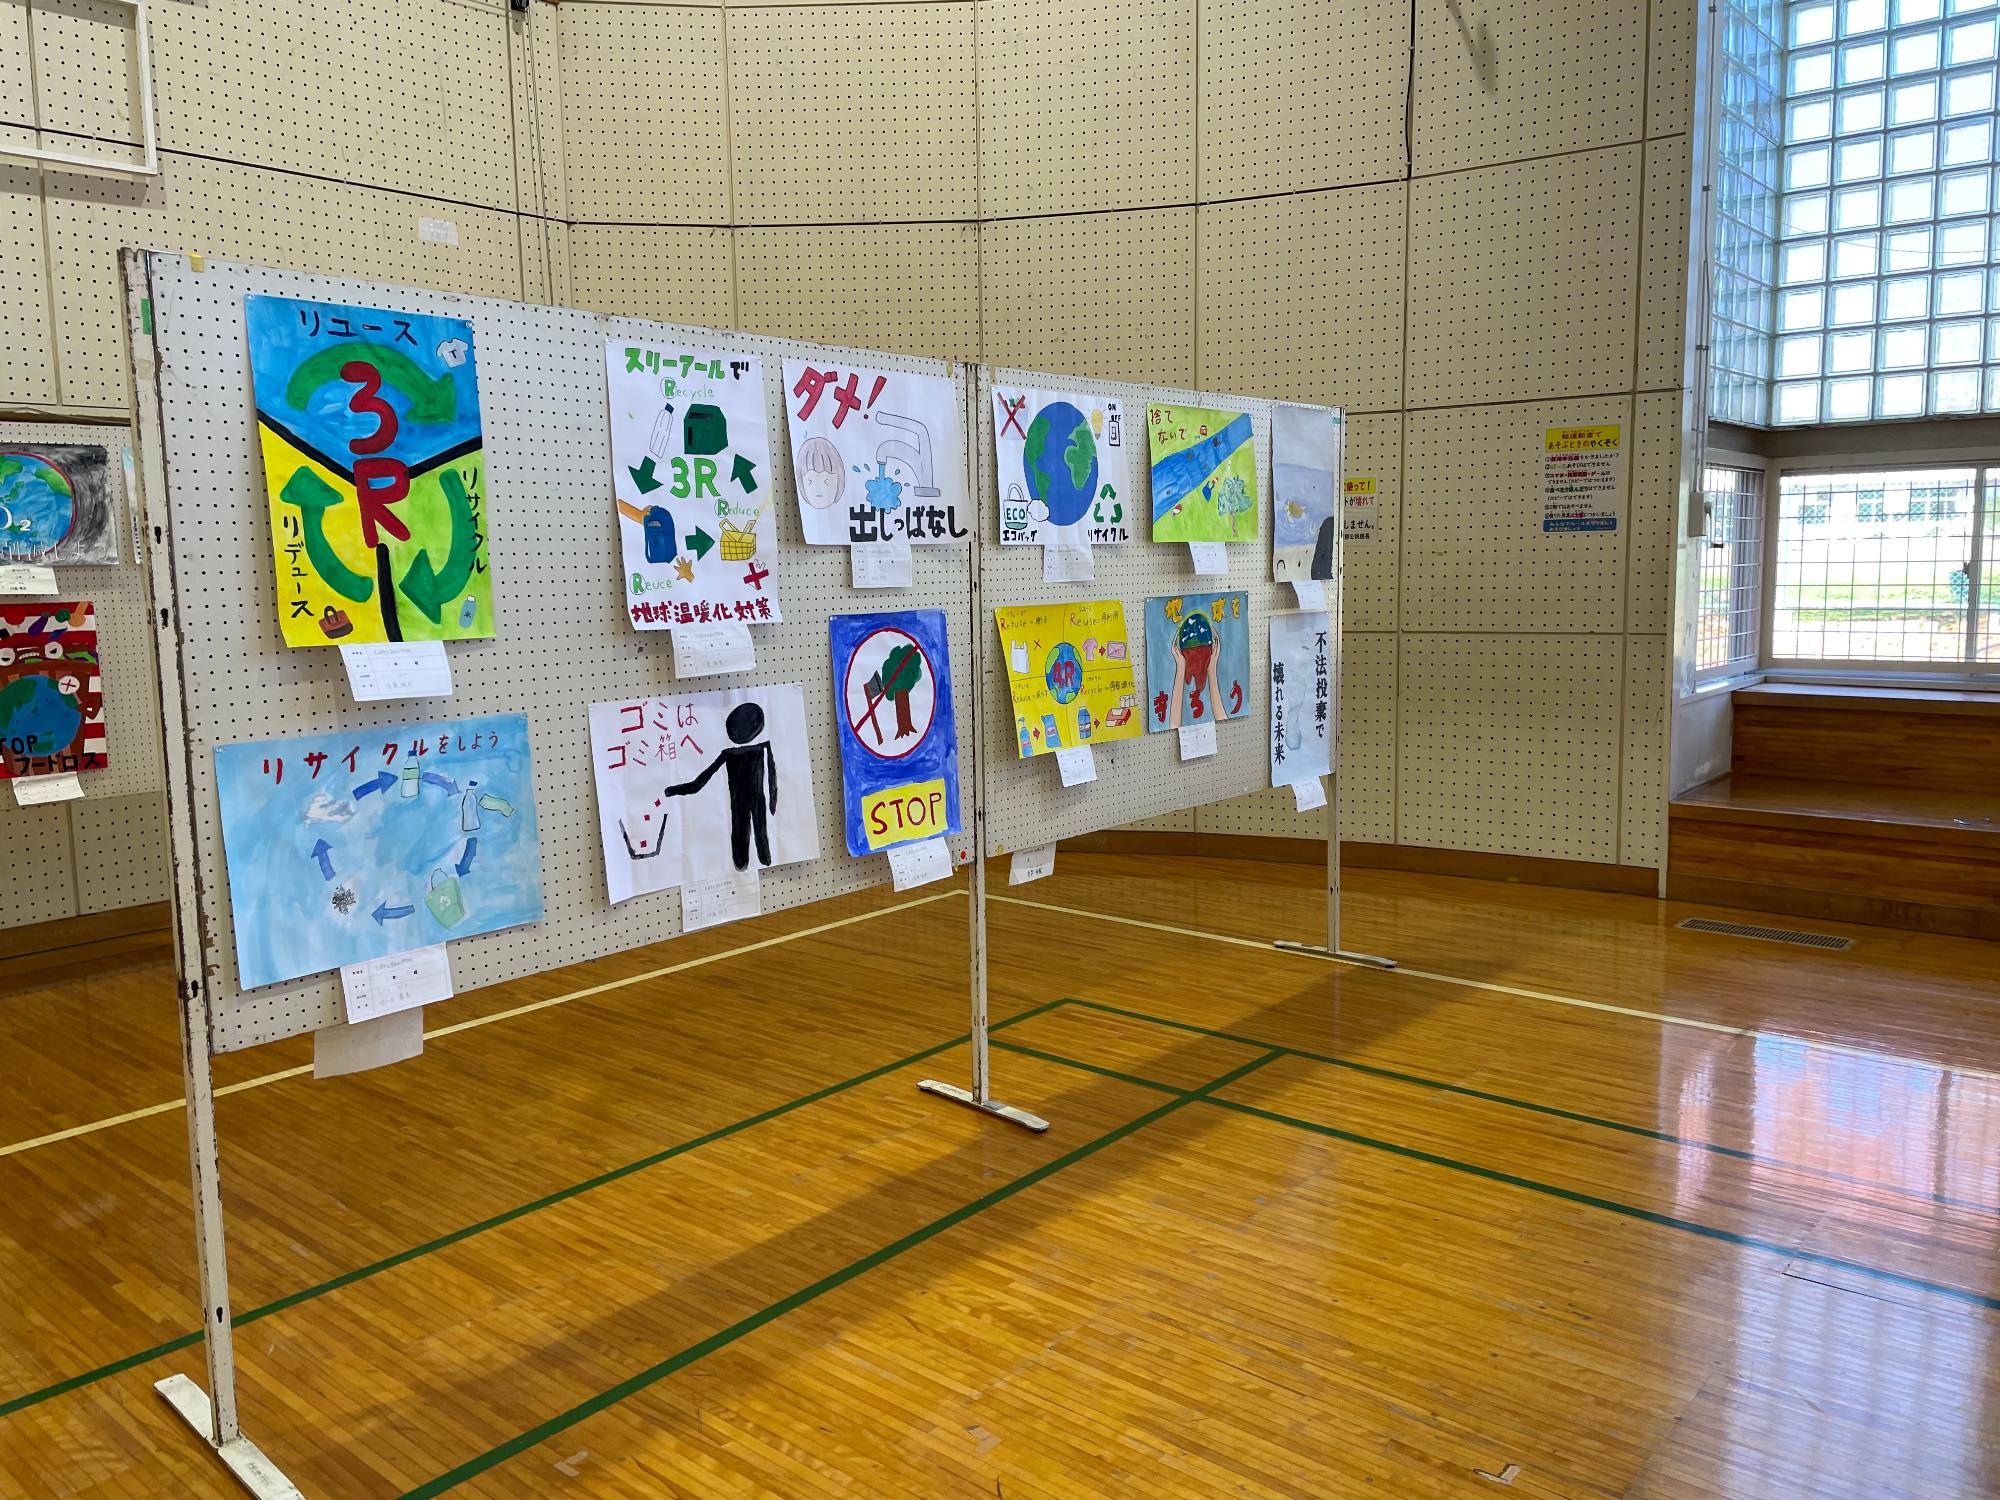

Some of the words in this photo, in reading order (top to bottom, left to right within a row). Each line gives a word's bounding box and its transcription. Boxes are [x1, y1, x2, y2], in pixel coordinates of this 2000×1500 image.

[300, 310, 418, 346] リユース
[624, 347, 749, 380] スリーアールで
[662, 378, 714, 402] Recycle
[792, 366, 887, 430] ダメ！
[1149, 408, 1173, 426] 捨て
[1157, 428, 1188, 445] ないで
[340, 361, 411, 548] 3R
[670, 456, 721, 498] 3R
[462, 467, 487, 574] リサイクル
[716, 498, 760, 518] Reduce
[1006, 508, 1026, 519] ECO
[1087, 530, 1129, 543] リサイクル
[282, 516, 314, 619] リデュース
[631, 597, 773, 625] 地球温暖化対策
[1053, 660, 1075, 688] 4R
[1314, 631, 1329, 739] 不法投棄で
[620, 701, 699, 734] ゴミは
[14, 752, 101, 775] フードロス
[263, 731, 500, 785] リサイクルをしよう
[607, 734, 704, 769] ゴミ箱へ
[870, 792, 942, 835] STOP
